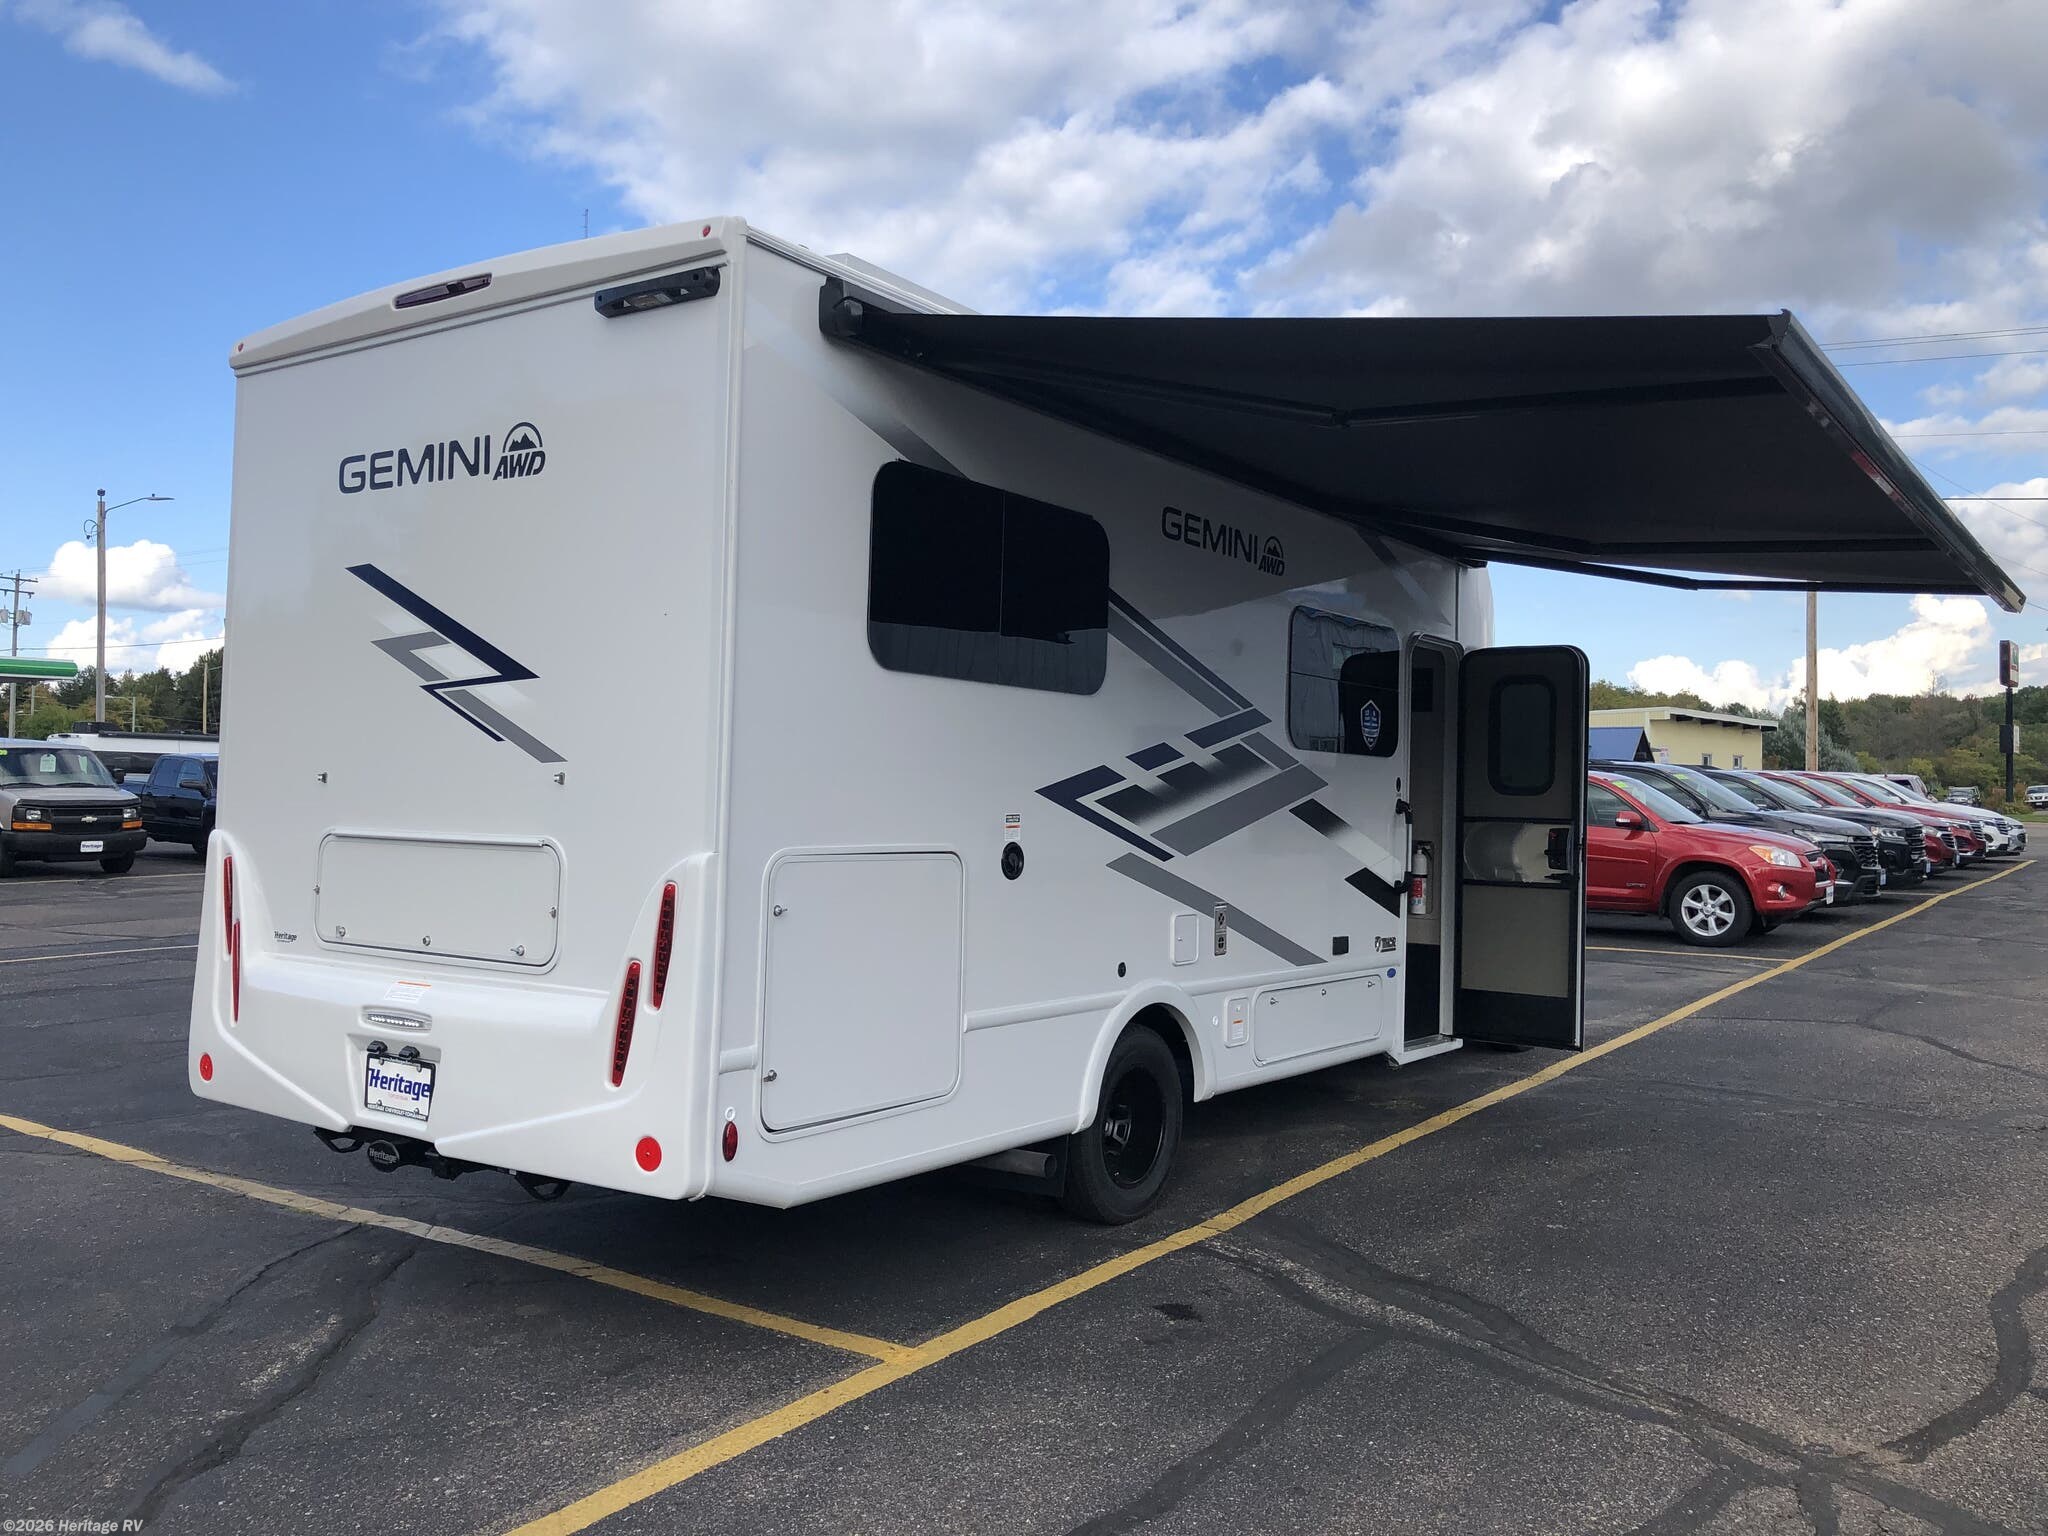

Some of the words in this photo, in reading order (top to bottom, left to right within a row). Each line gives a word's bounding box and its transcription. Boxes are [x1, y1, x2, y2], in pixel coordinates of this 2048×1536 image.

[339, 435, 490, 494] GEMINI
[492, 450, 546, 481] AWD
[1161, 506, 1258, 565] GEMINI
[1258, 554, 1285, 577] AWD
[274, 931, 297, 942] Heritage
[369, 1067, 431, 1101] Heritage
[369, 1147, 398, 1163] Heritage
